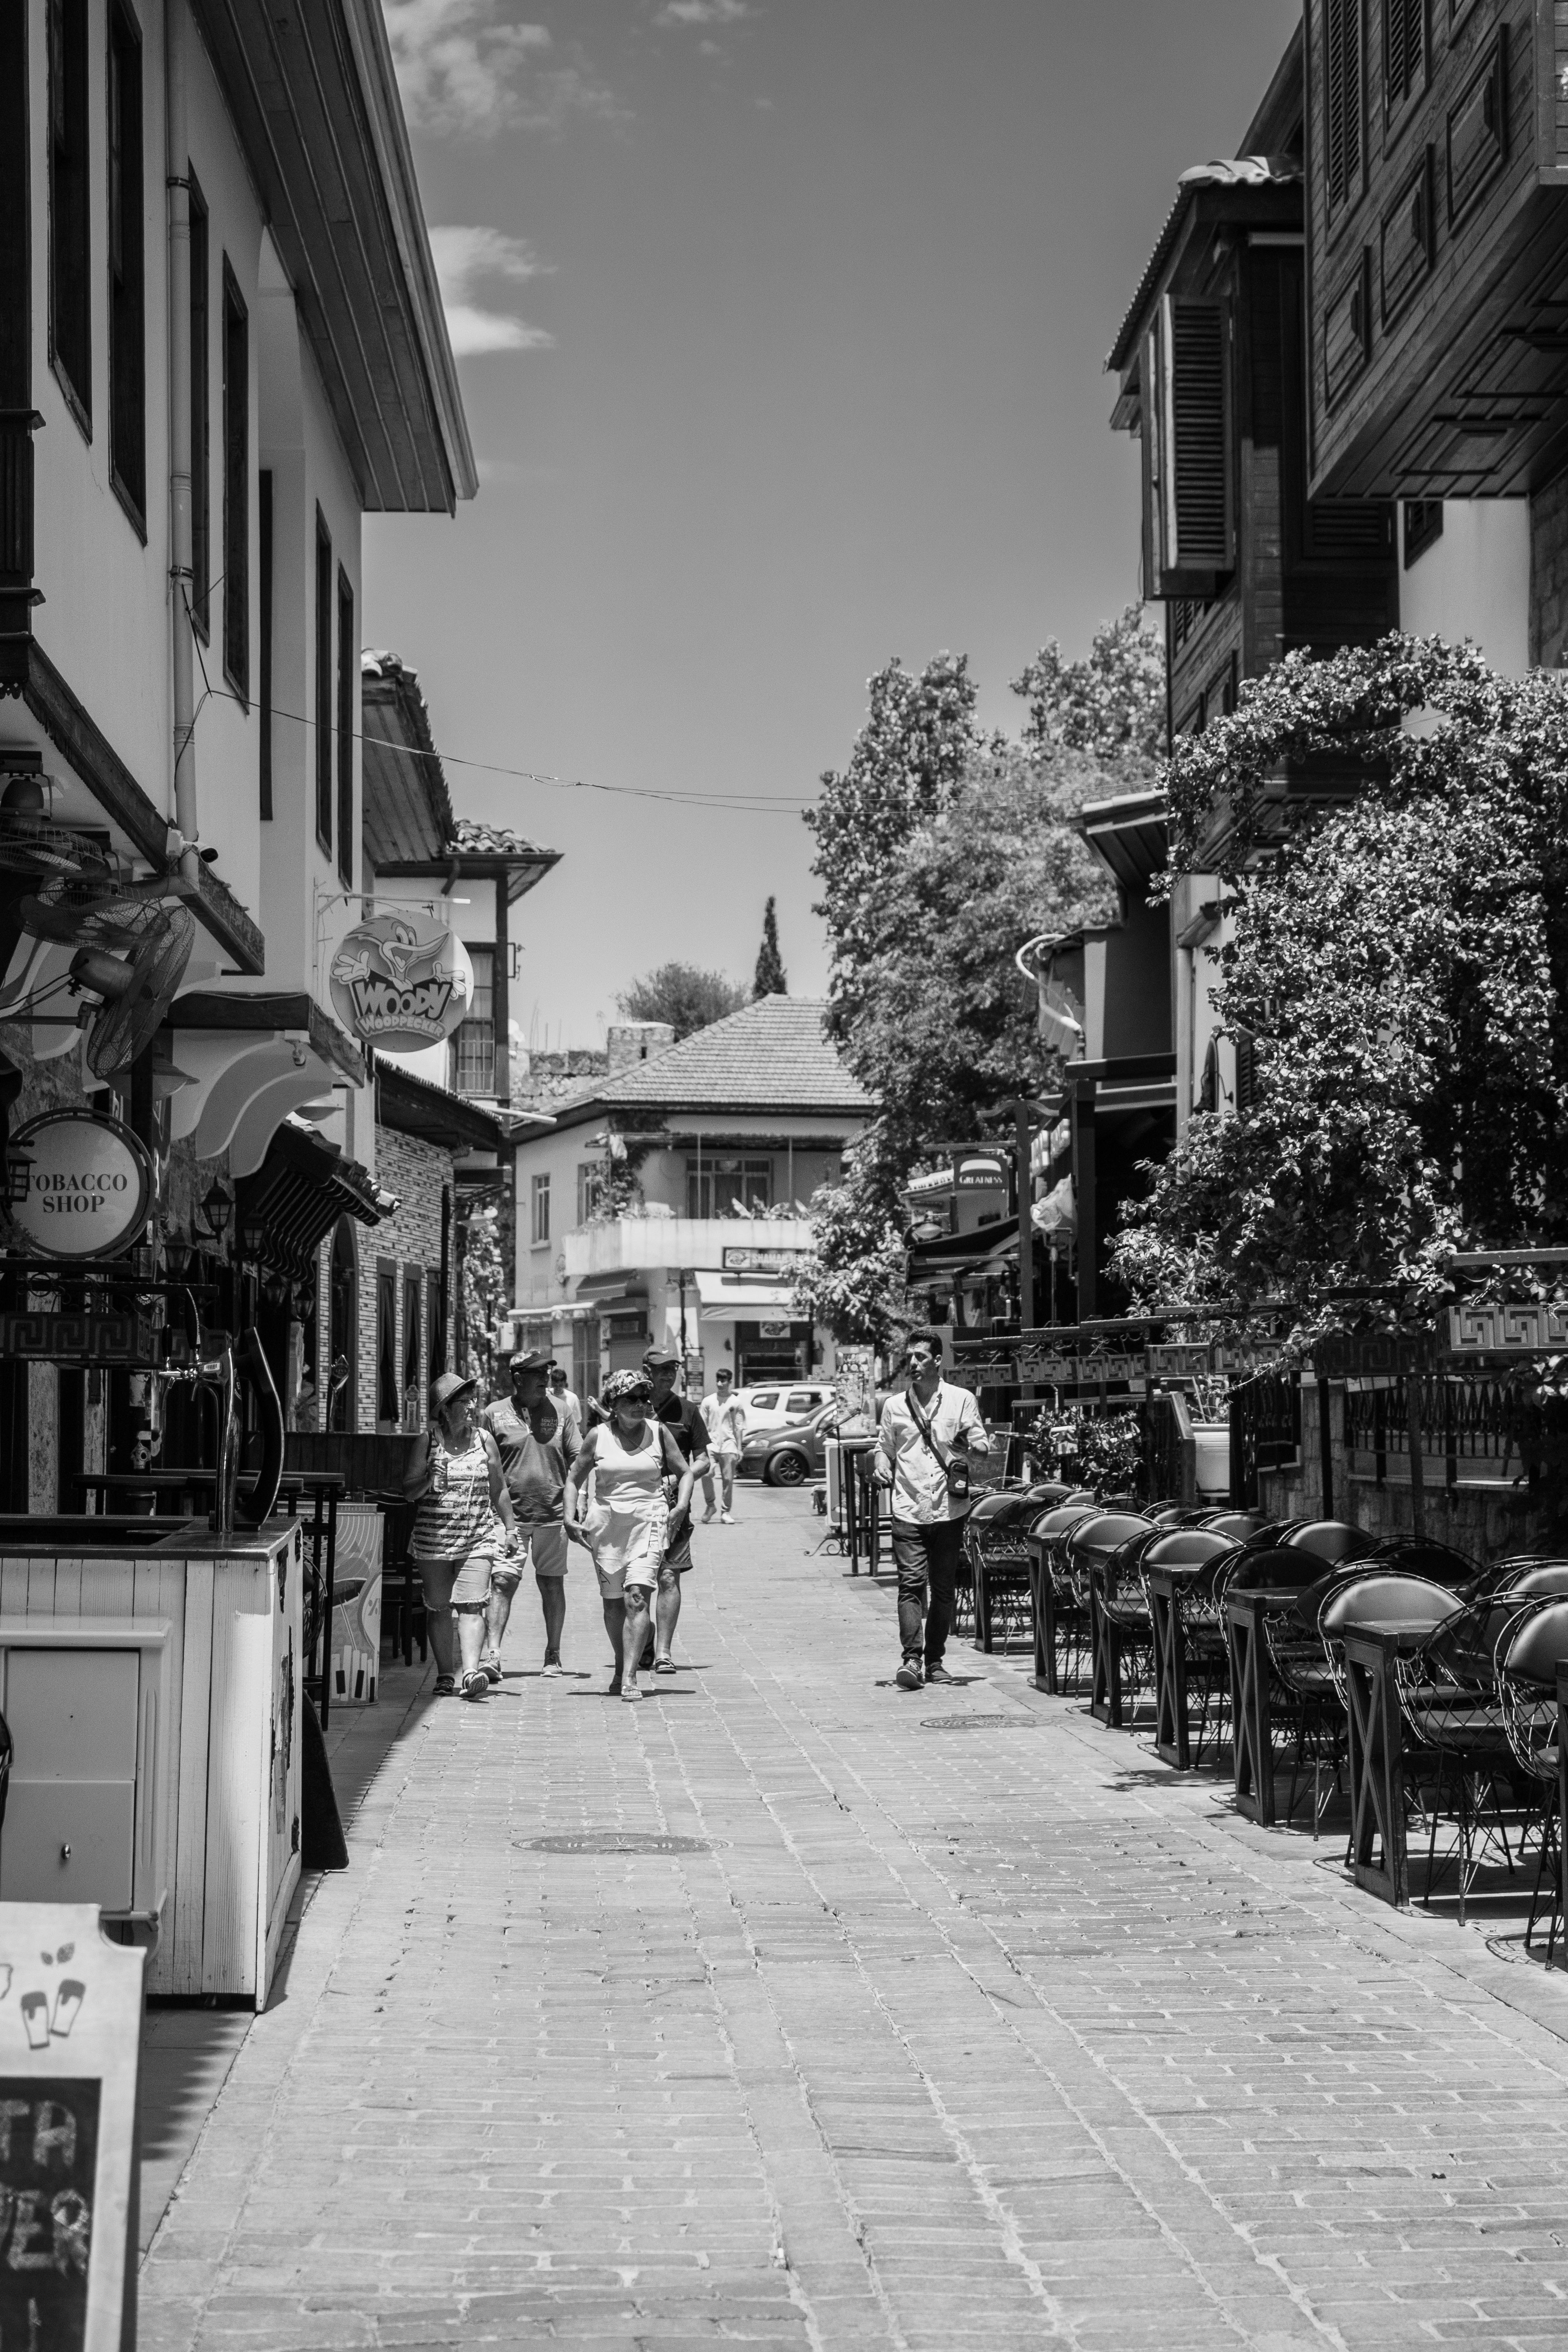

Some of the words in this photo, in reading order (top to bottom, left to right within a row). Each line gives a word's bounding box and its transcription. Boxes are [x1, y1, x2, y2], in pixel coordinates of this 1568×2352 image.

[354, 981, 451, 1018] WOODY
[359, 1014, 443, 1036] WOODPECKER
[43, 1195, 105, 1213] SHOP
